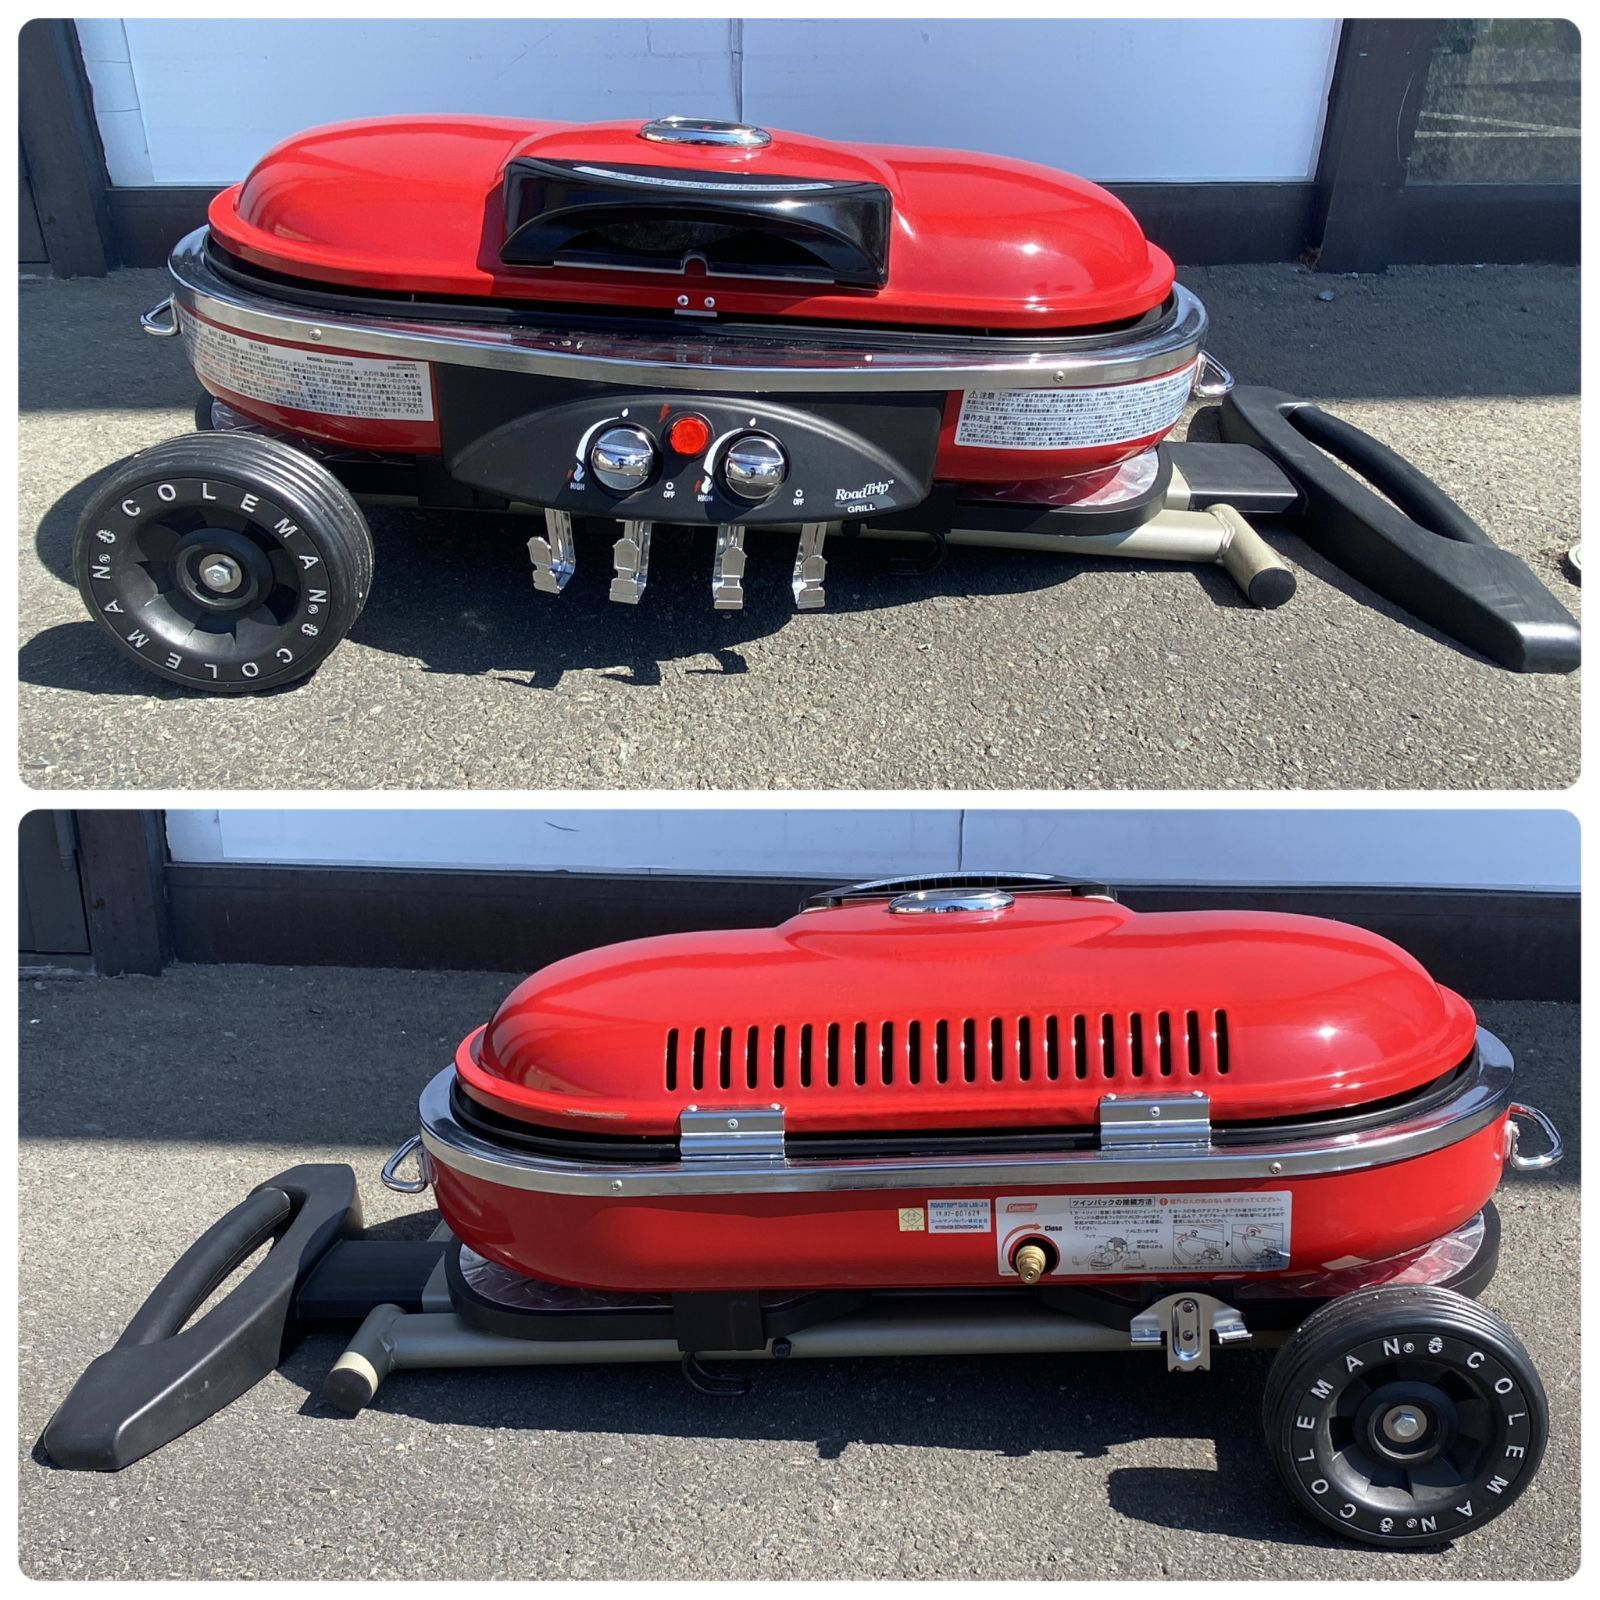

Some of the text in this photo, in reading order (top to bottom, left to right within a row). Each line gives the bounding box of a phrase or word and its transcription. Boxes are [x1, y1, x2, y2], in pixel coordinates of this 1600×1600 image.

[963, 414, 990, 423] 操作方法
[570, 482, 585, 491] HIGH
[663, 490, 675, 499] OFF
[697, 494, 713, 502] HIGH
[793, 497, 804, 506] OFF
[847, 504, 876, 513] GRILL
